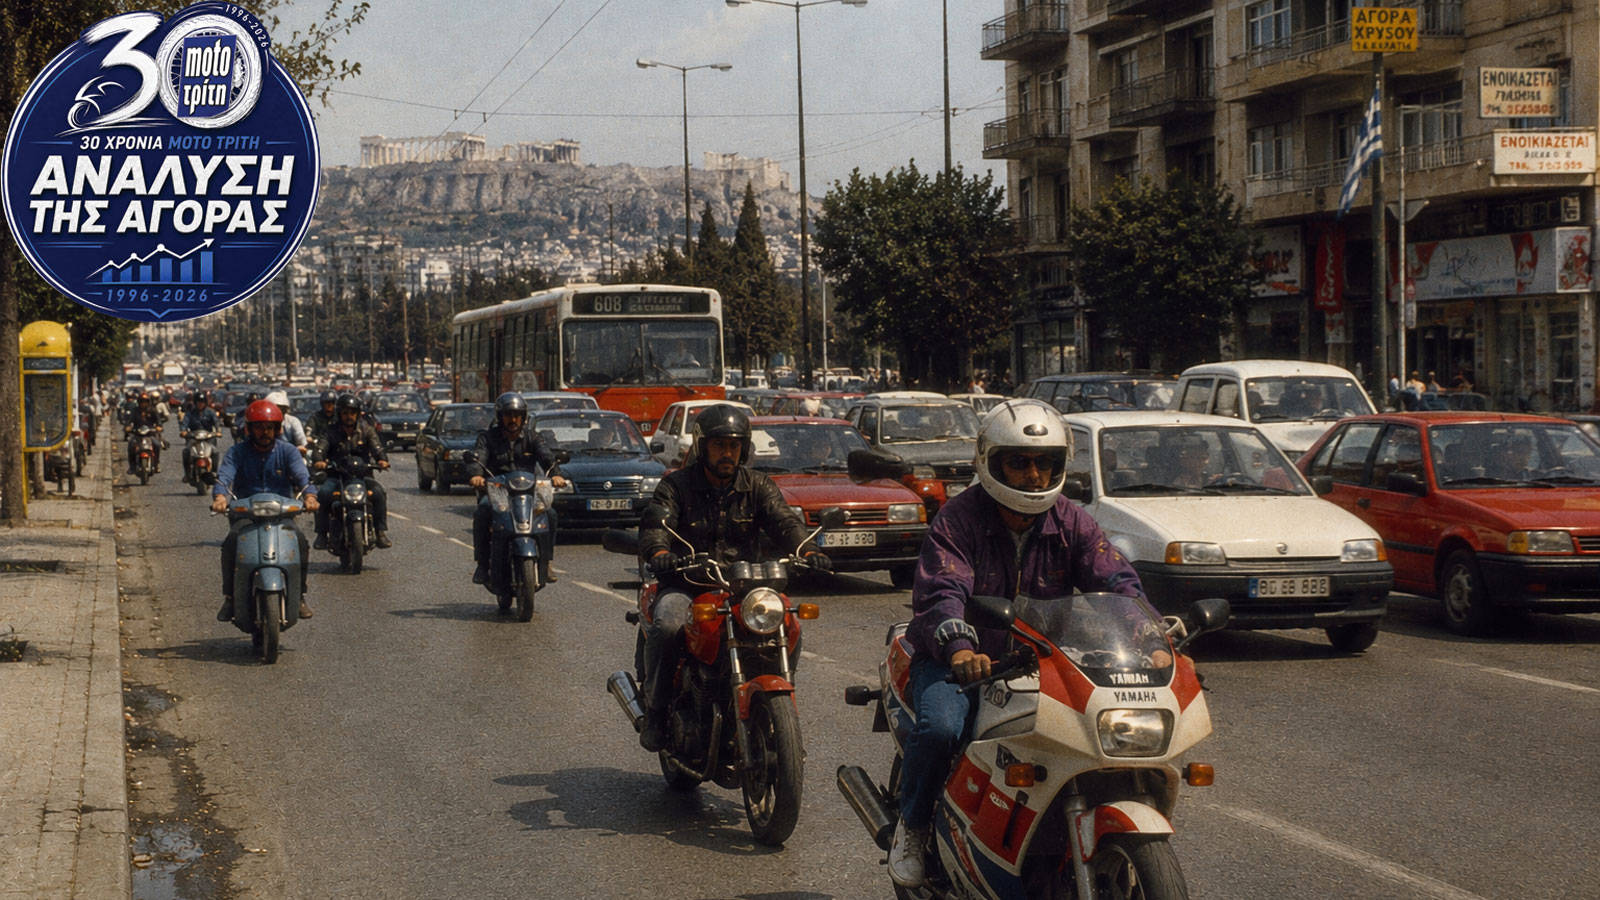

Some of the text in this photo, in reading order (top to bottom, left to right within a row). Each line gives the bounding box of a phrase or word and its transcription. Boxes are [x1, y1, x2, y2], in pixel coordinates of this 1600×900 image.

[1356, 9, 1411, 24] ΑΓΟΡΑ
[1500, 135, 1589, 149] ΕΝΟΙΚΙΑΖΕΤΑΙ
[594, 295, 622, 312] 608
[1114, 691, 1157, 703] YAMAHA
